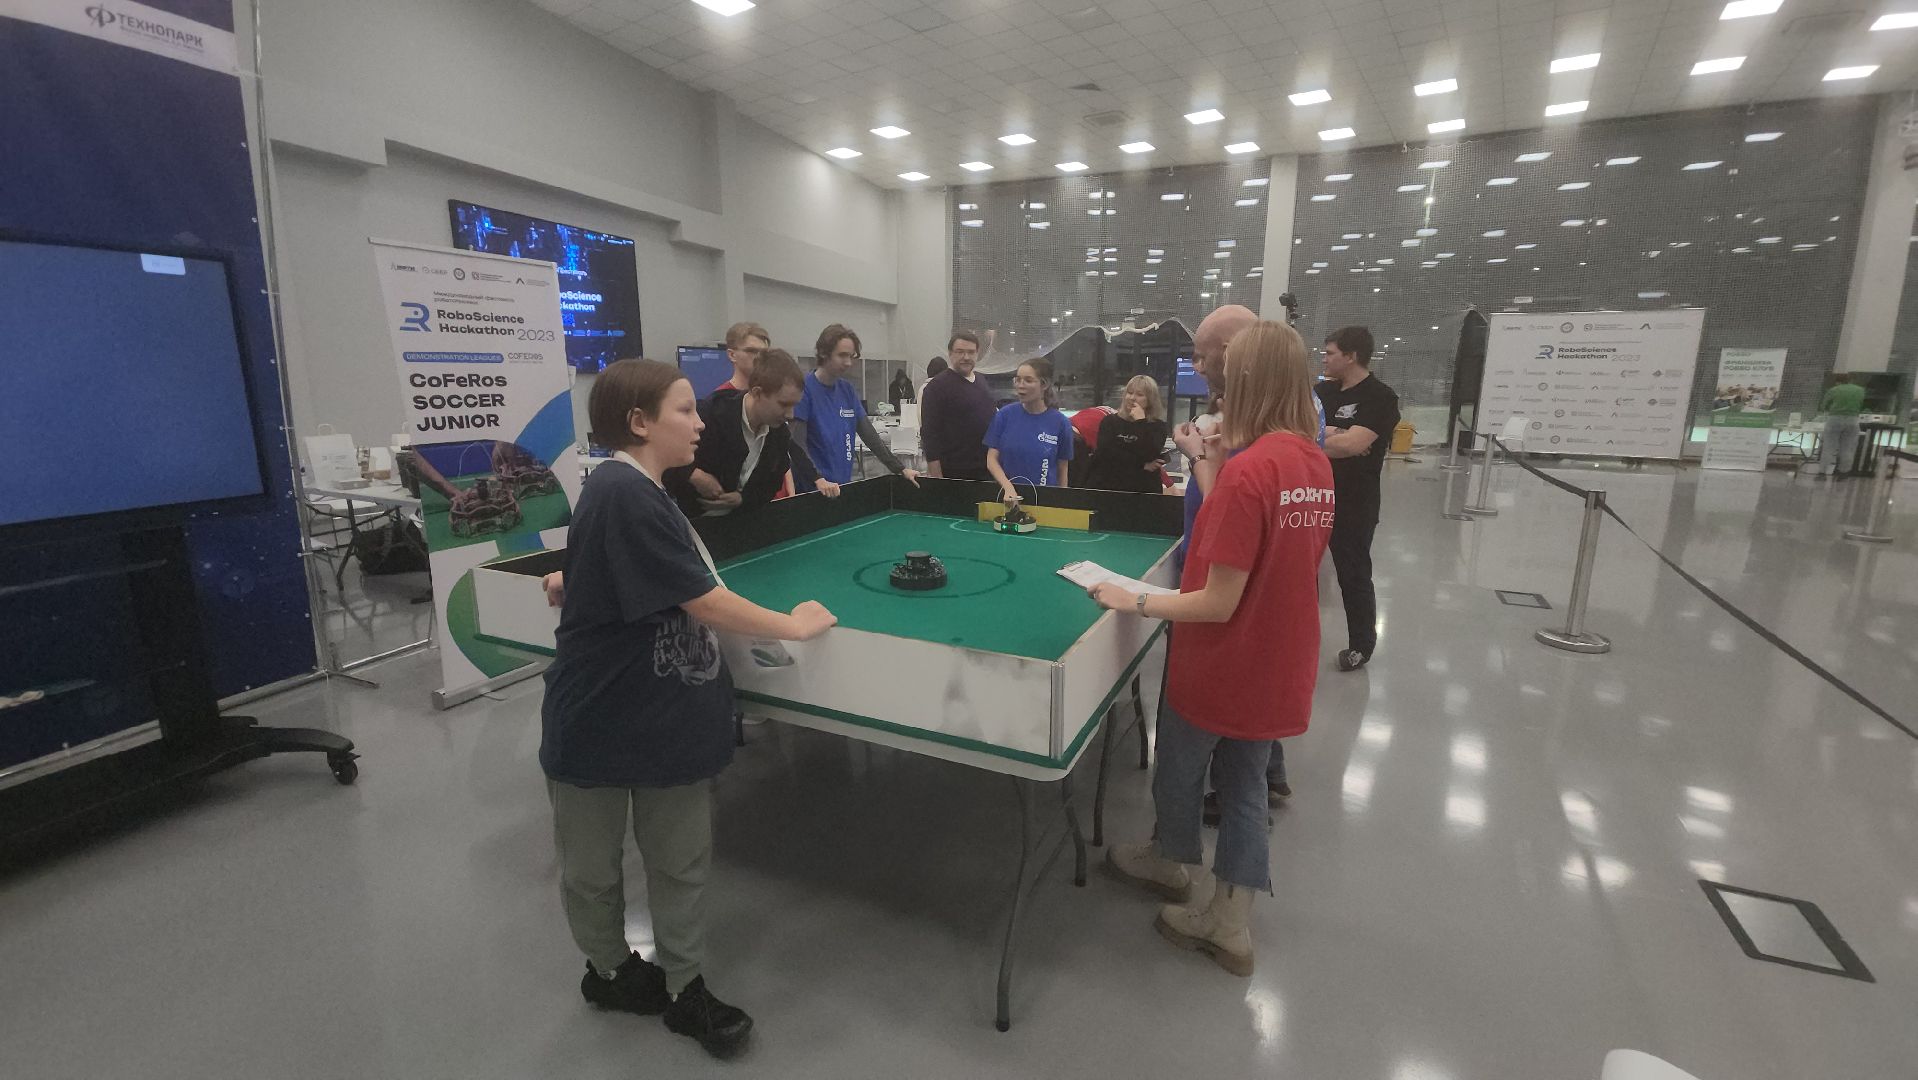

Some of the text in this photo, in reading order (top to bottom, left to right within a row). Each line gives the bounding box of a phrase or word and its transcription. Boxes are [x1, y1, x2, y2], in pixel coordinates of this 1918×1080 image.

[117, 12, 204, 48] ТЕХНОПАРК
[560, 290, 602, 302] oScience
[560, 301, 596, 312] kathon
[437, 309, 525, 324] RoboScience
[439, 323, 515, 336] Hackathon
[517, 328, 556, 342] 2023
[406, 353, 470, 362] DEMONSTRATION
[1611, 354, 1641, 362] 2023
[409, 373, 508, 388] CoFeRos
[412, 393, 506, 410] SOCCER
[416, 414, 501, 432] JUNIOR
